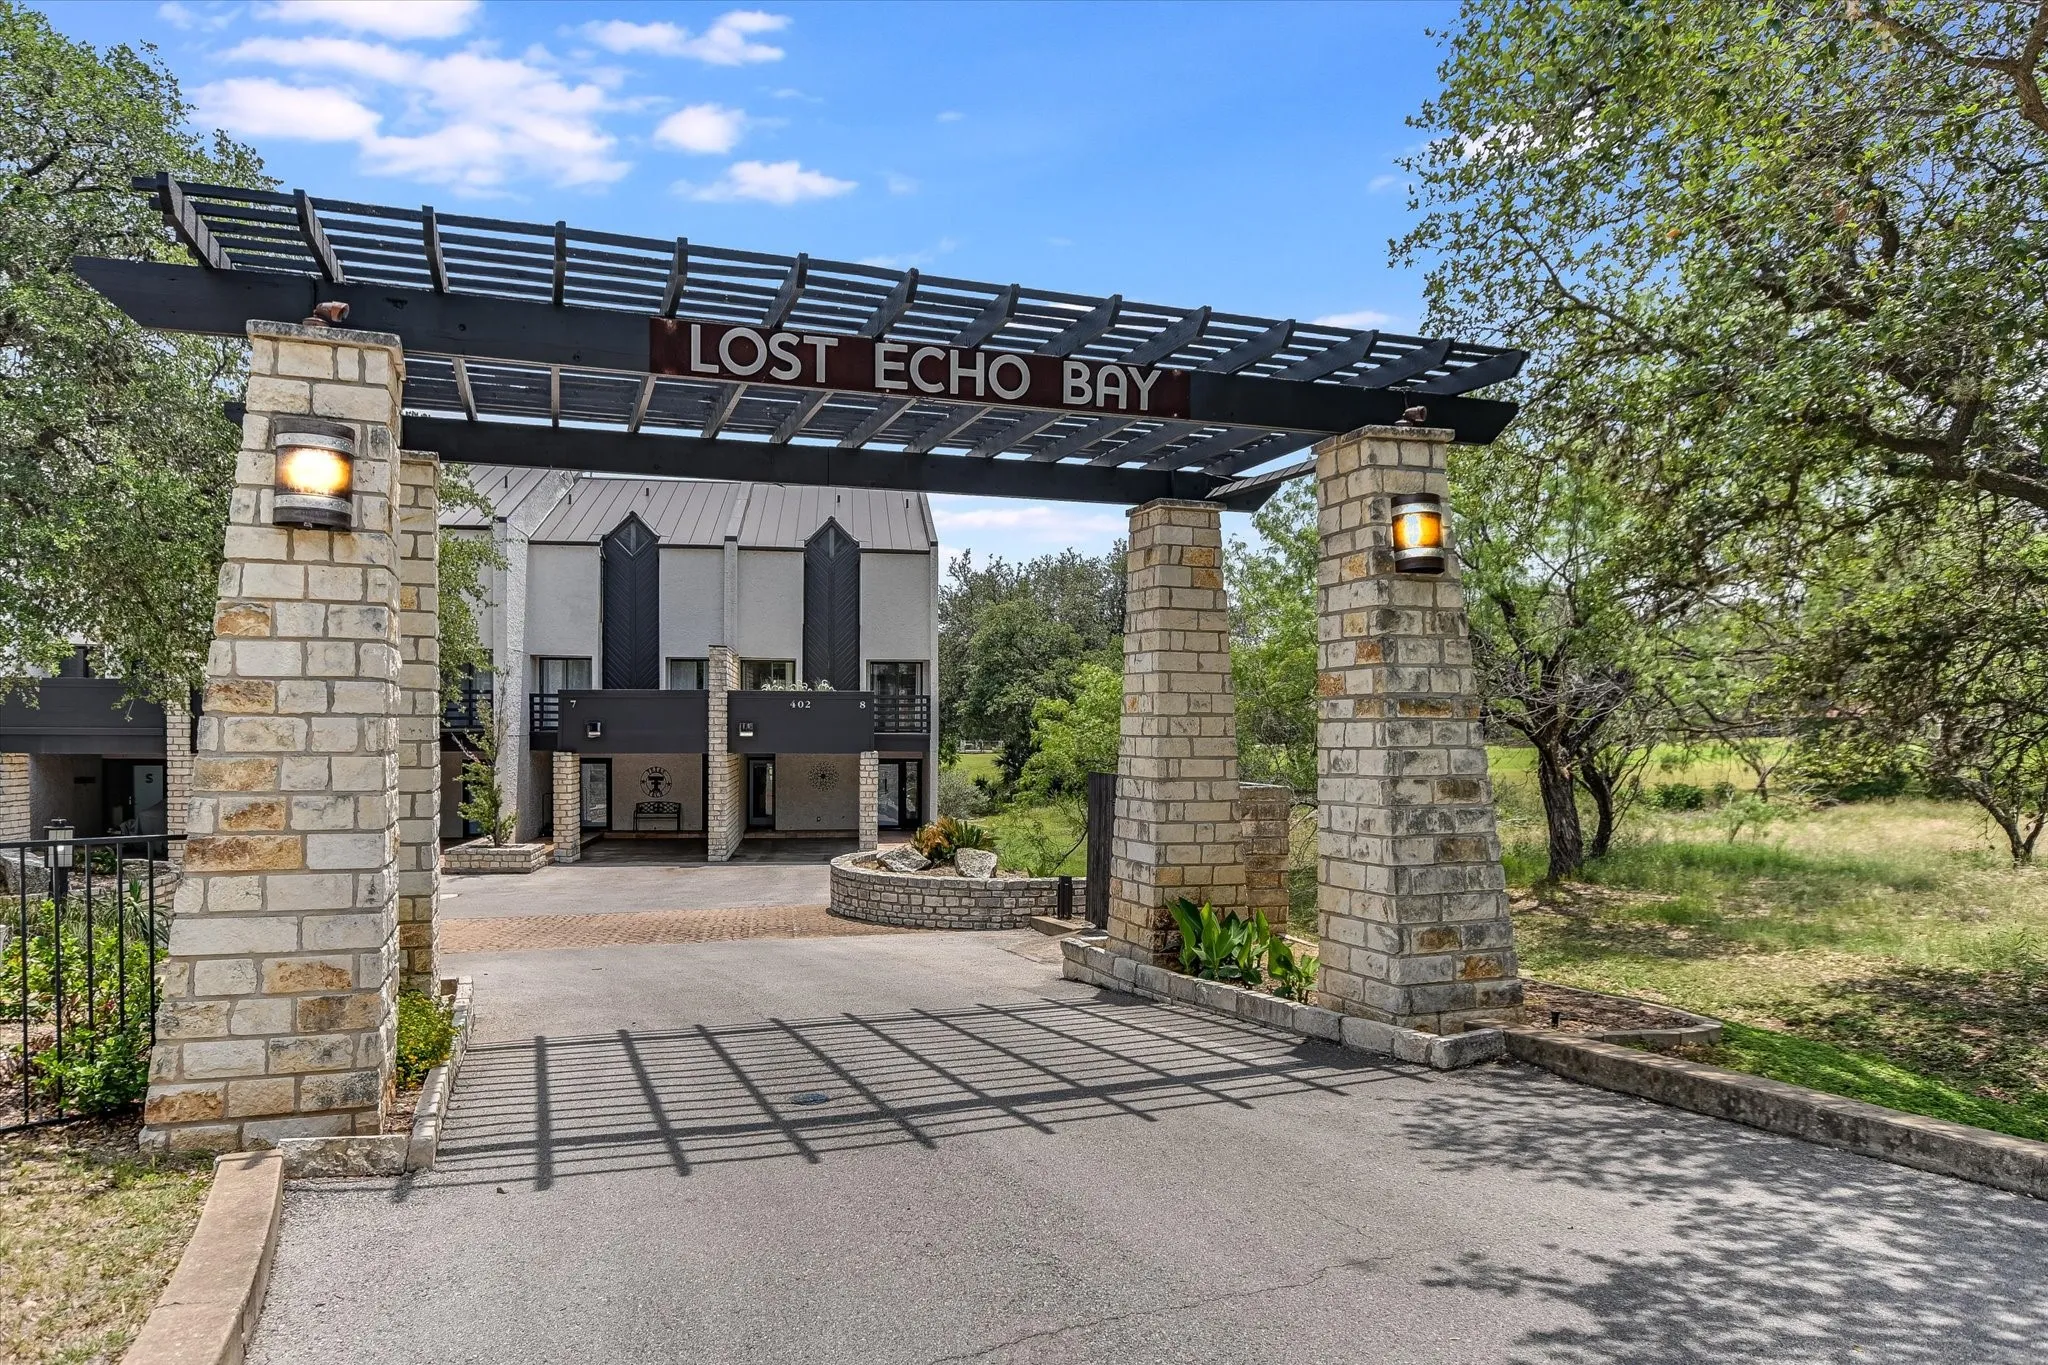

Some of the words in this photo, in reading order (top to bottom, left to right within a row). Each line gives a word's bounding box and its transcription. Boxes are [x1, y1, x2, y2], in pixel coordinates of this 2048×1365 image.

[691, 324, 837, 383] LOST
[875, 343, 1030, 400] ECHO
[1063, 361, 1162, 410] BAY
[570, 700, 577, 709] 7
[789, 700, 811, 709] 402
[859, 700, 866, 709] 8
